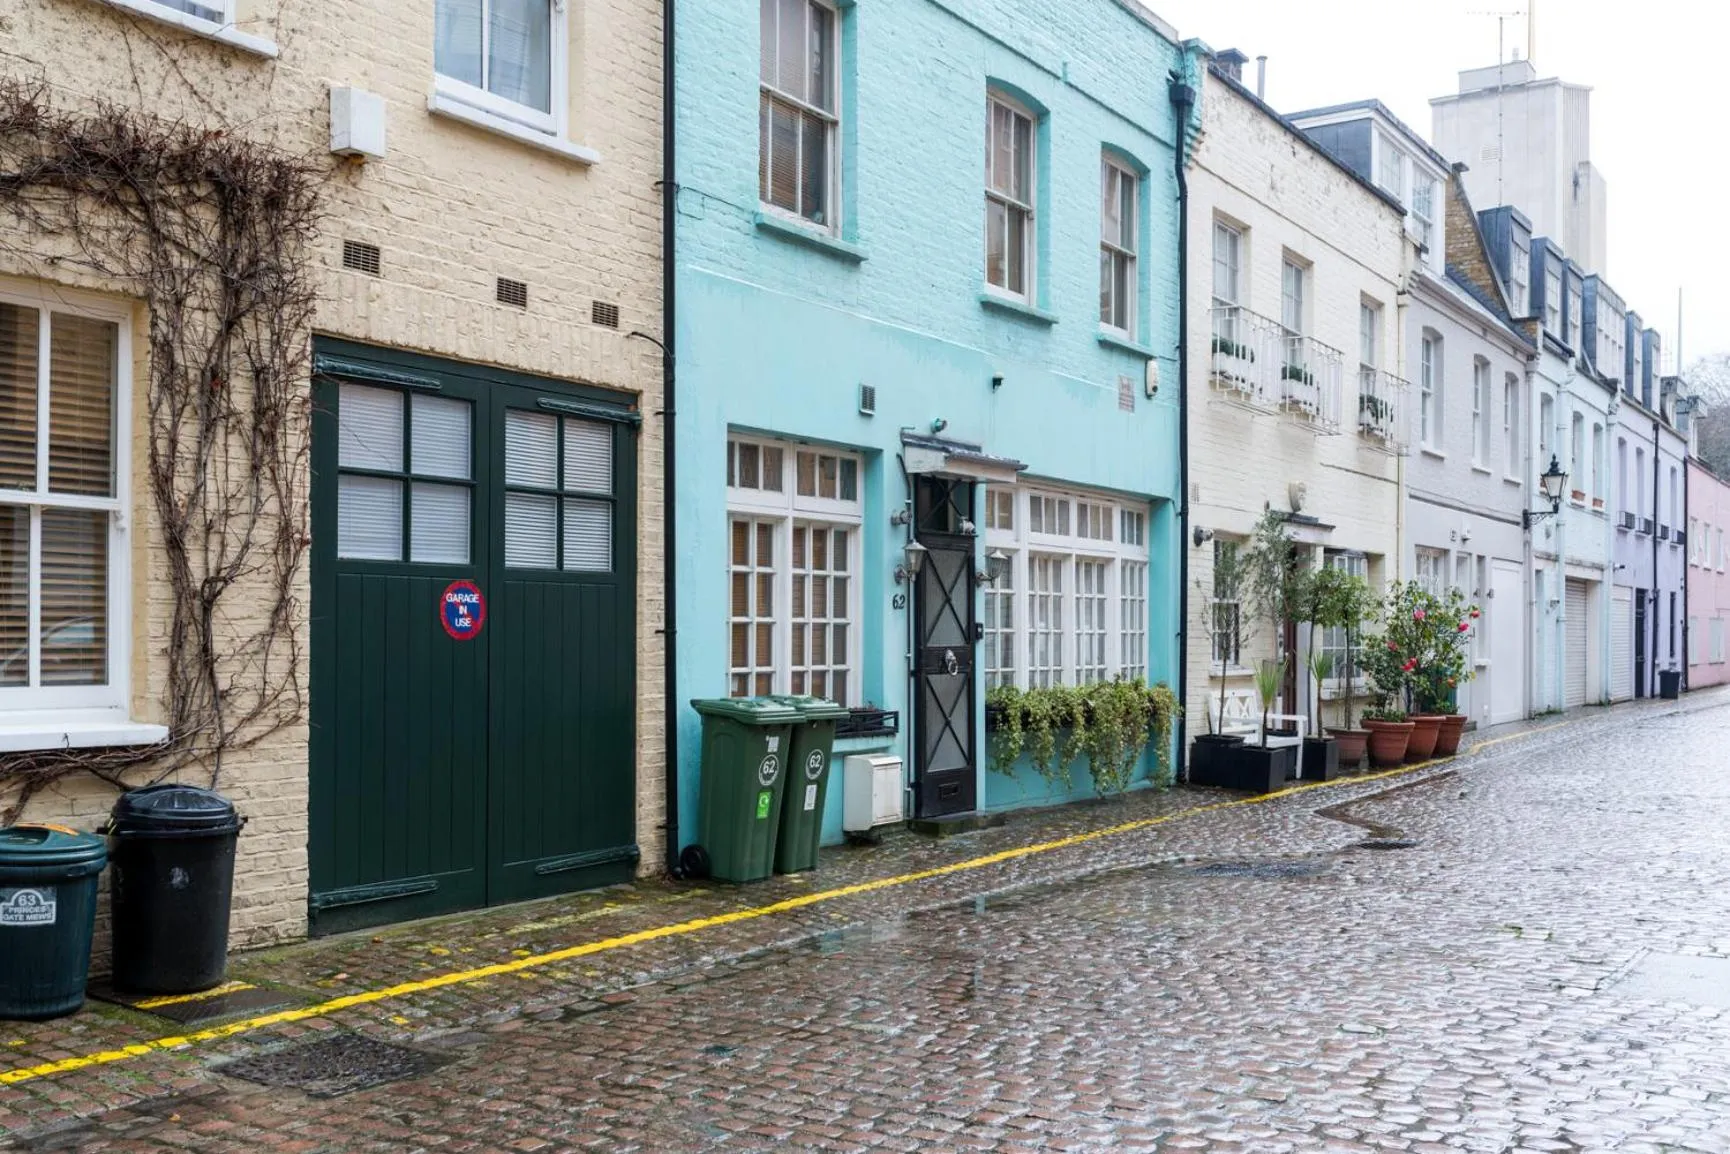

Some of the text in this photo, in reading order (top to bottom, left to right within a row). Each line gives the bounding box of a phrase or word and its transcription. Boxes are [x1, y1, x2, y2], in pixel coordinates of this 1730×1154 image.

[446, 593, 479, 603] GARAGE
[892, 594, 905, 610] 62
[459, 605, 467, 614] IN
[455, 617, 472, 627] USE
[809, 755, 821, 768] 62
[763, 760, 776, 774] 62
[18, 895, 36, 906] 63
[25, 912, 52, 920] MEWS
